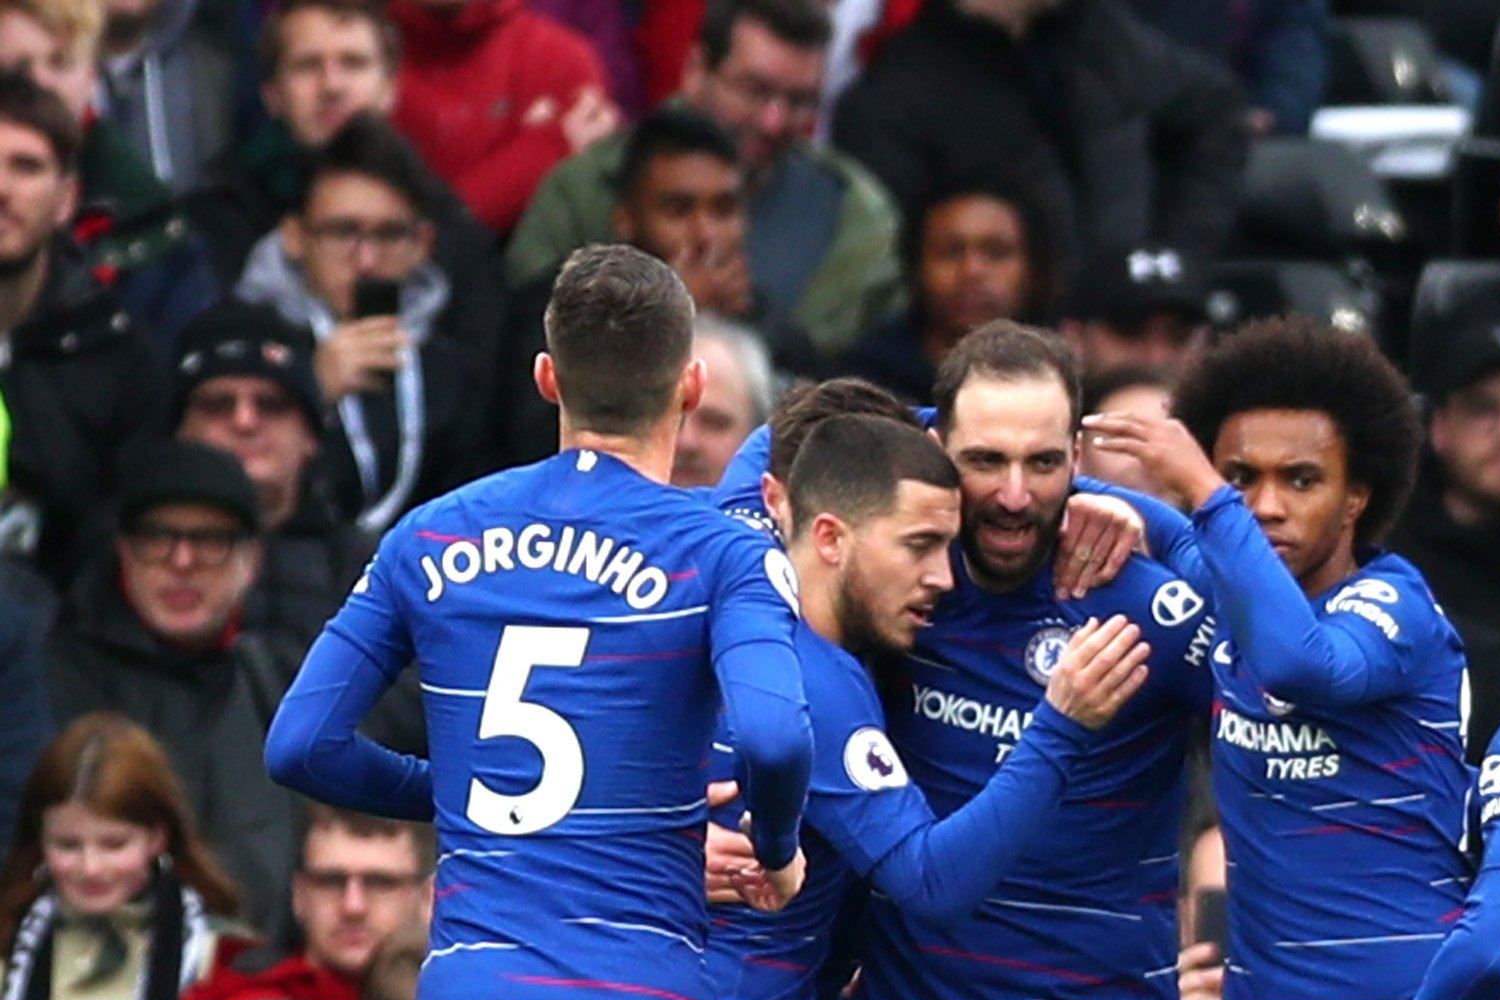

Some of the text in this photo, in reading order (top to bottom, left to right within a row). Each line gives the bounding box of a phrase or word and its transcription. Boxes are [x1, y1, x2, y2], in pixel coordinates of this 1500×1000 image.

[420, 523, 669, 611] JORGINHO
[466, 625, 591, 835] 5
[912, 683, 1034, 741] YOKOHA
[1216, 708, 1338, 753] YOKOHAMA
[1265, 753, 1341, 780] TYRES
